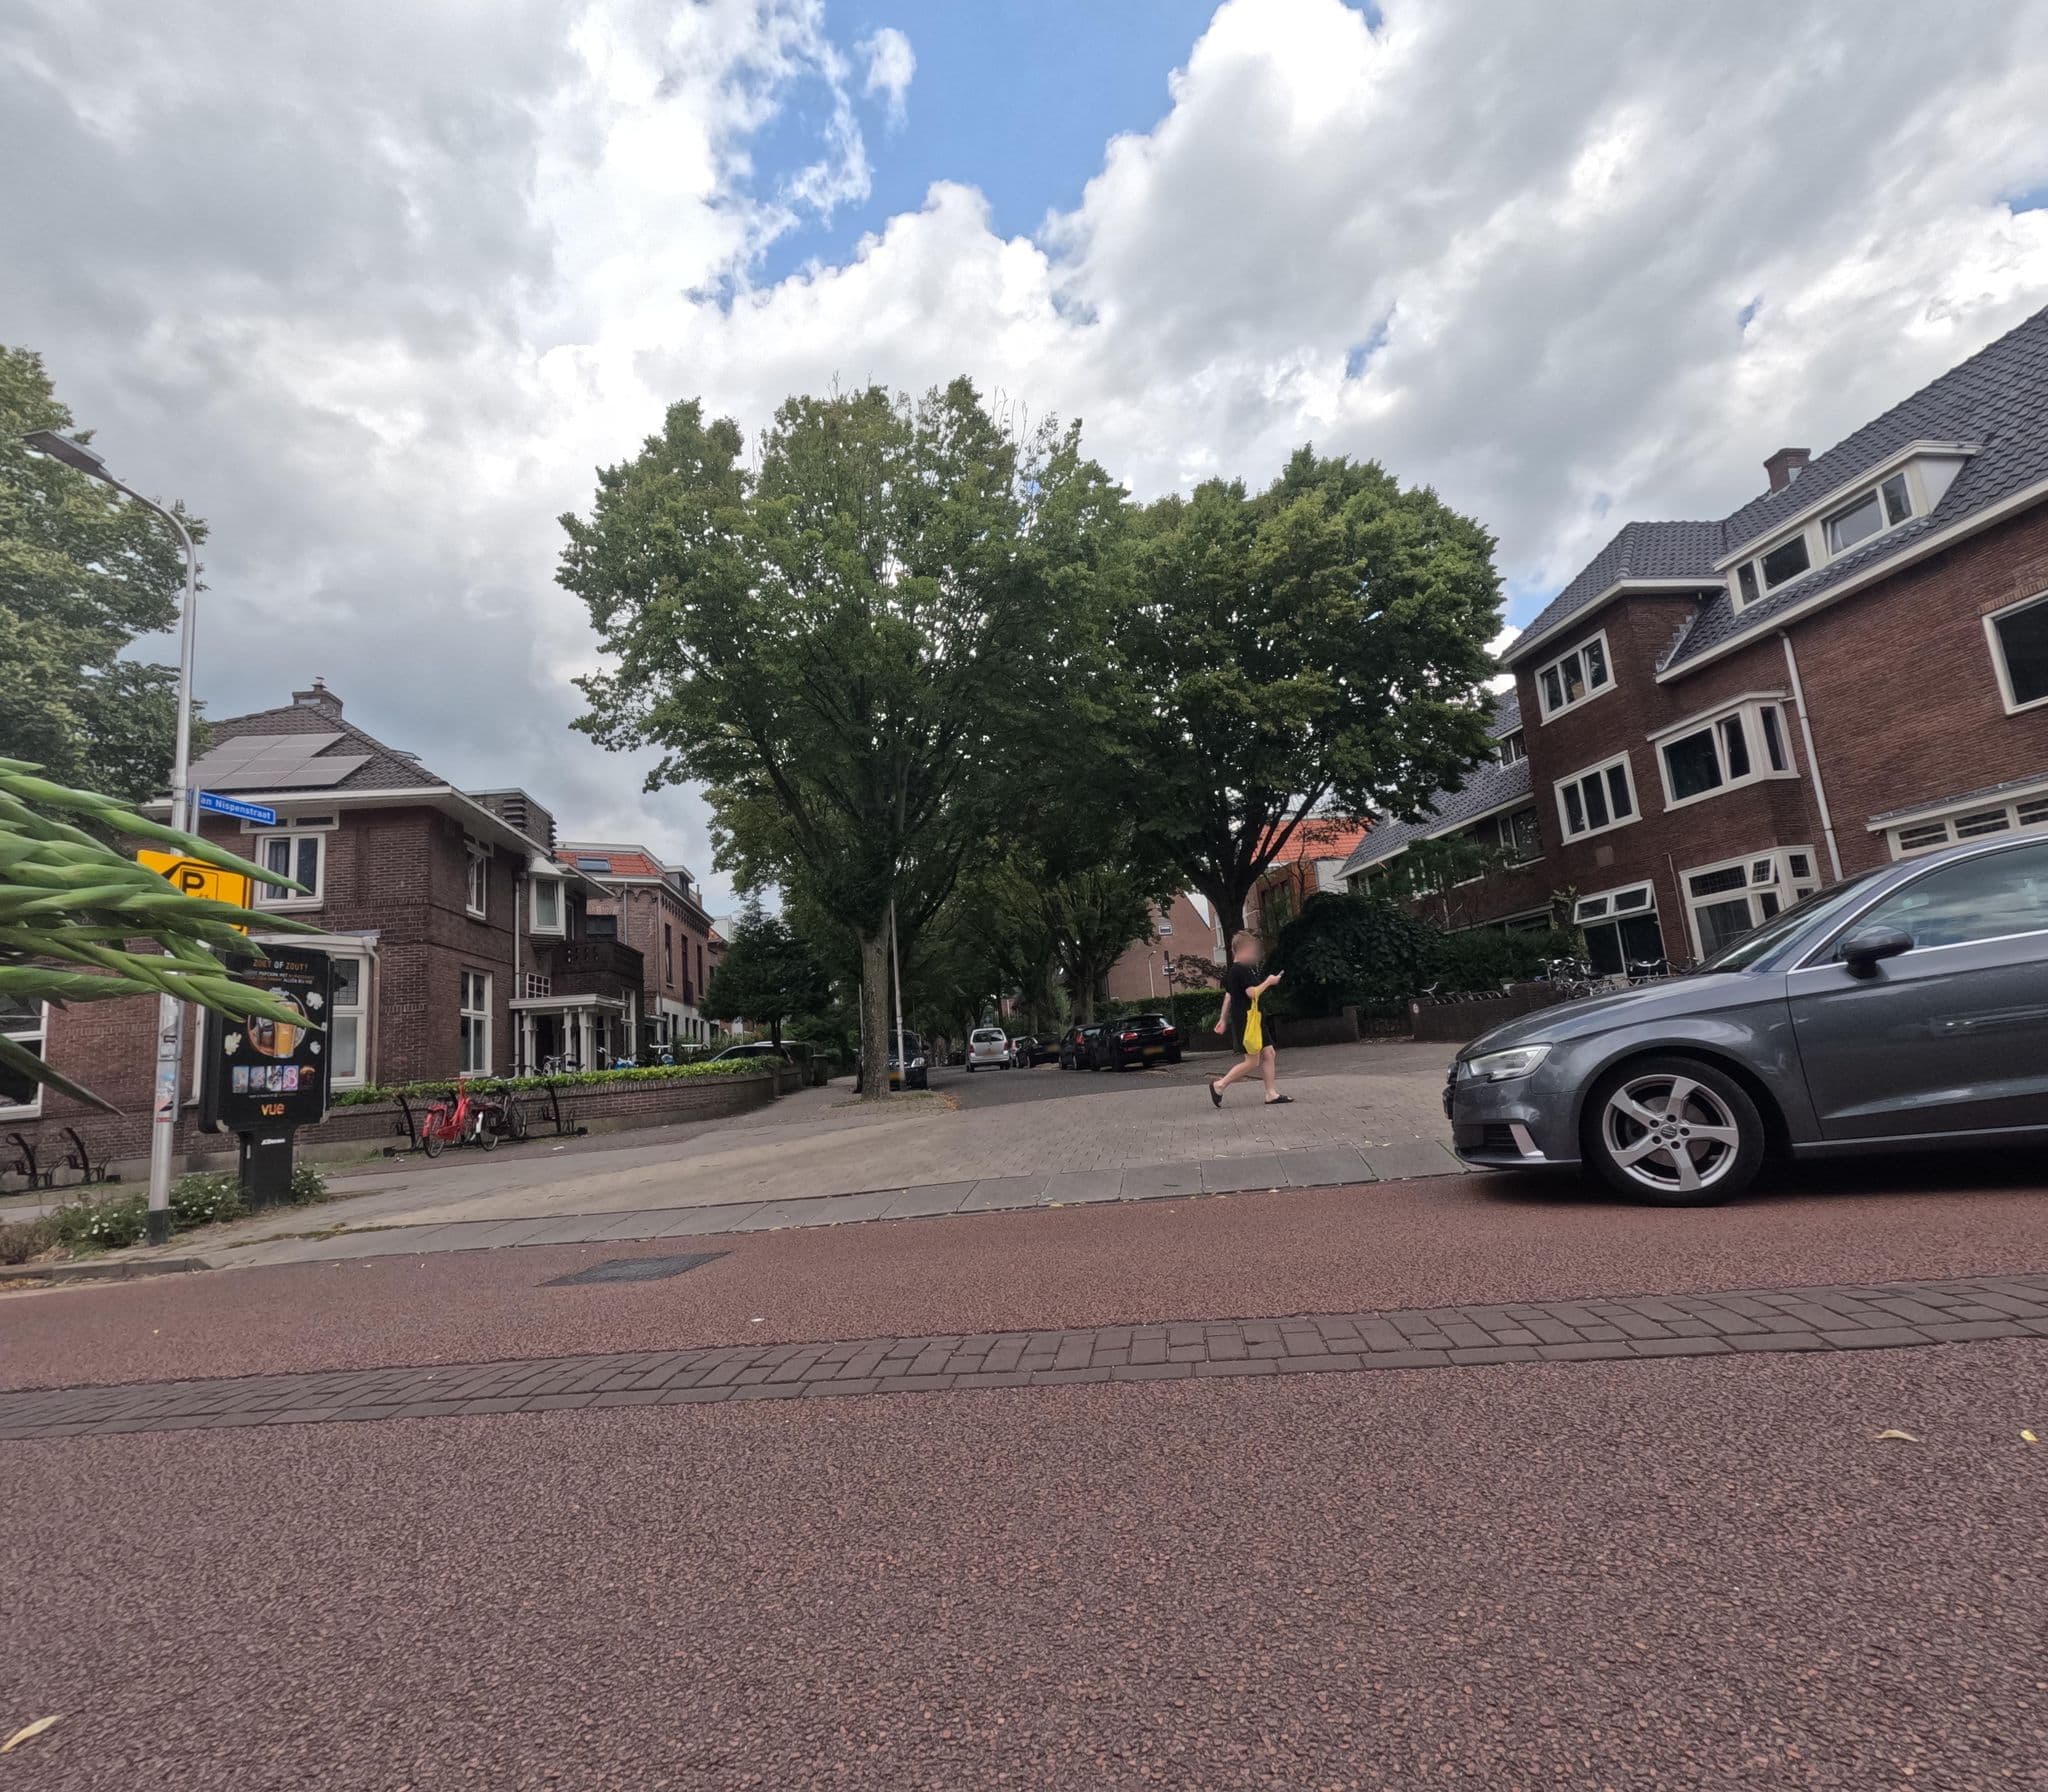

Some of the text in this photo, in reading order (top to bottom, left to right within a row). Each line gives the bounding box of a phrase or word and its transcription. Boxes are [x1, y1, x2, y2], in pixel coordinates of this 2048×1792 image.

[215, 799, 271, 820] Nispenstraat
[182, 870, 205, 896] P
[273, 960, 285, 969] OF
